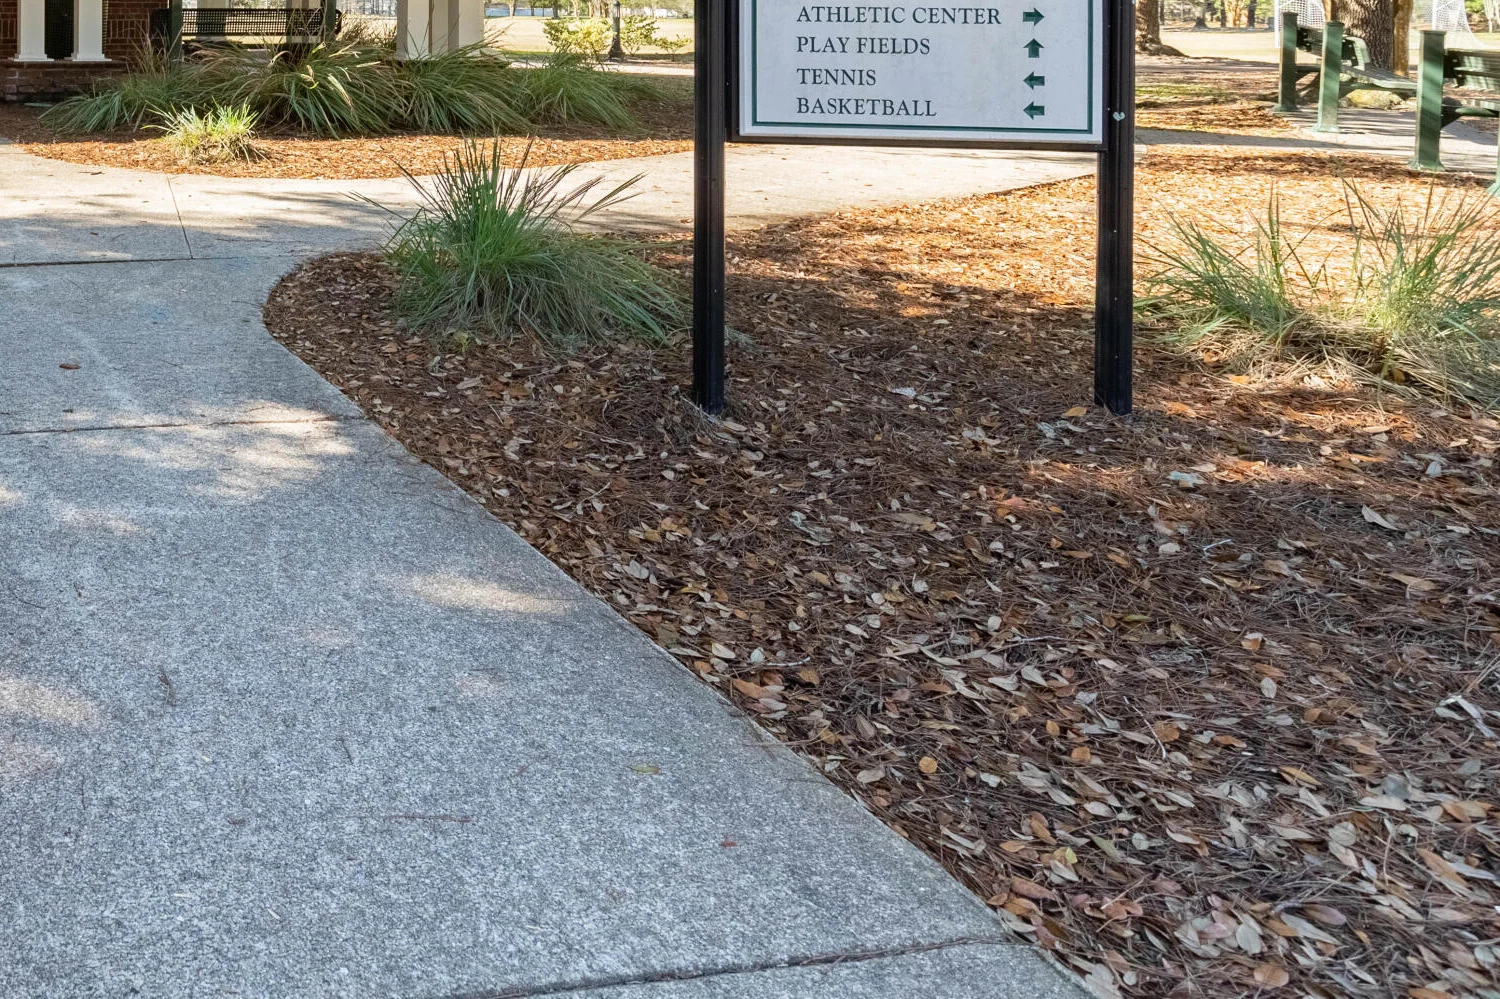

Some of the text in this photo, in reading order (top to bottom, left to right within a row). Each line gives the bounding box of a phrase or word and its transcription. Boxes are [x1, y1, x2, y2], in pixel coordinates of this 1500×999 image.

[797, 6, 1002, 26] ATHLETIC CENTER
[797, 36, 930, 56] PLAY FIELDS
[797, 68, 876, 86] TENNIS
[797, 97, 937, 117] BASKETBALL
